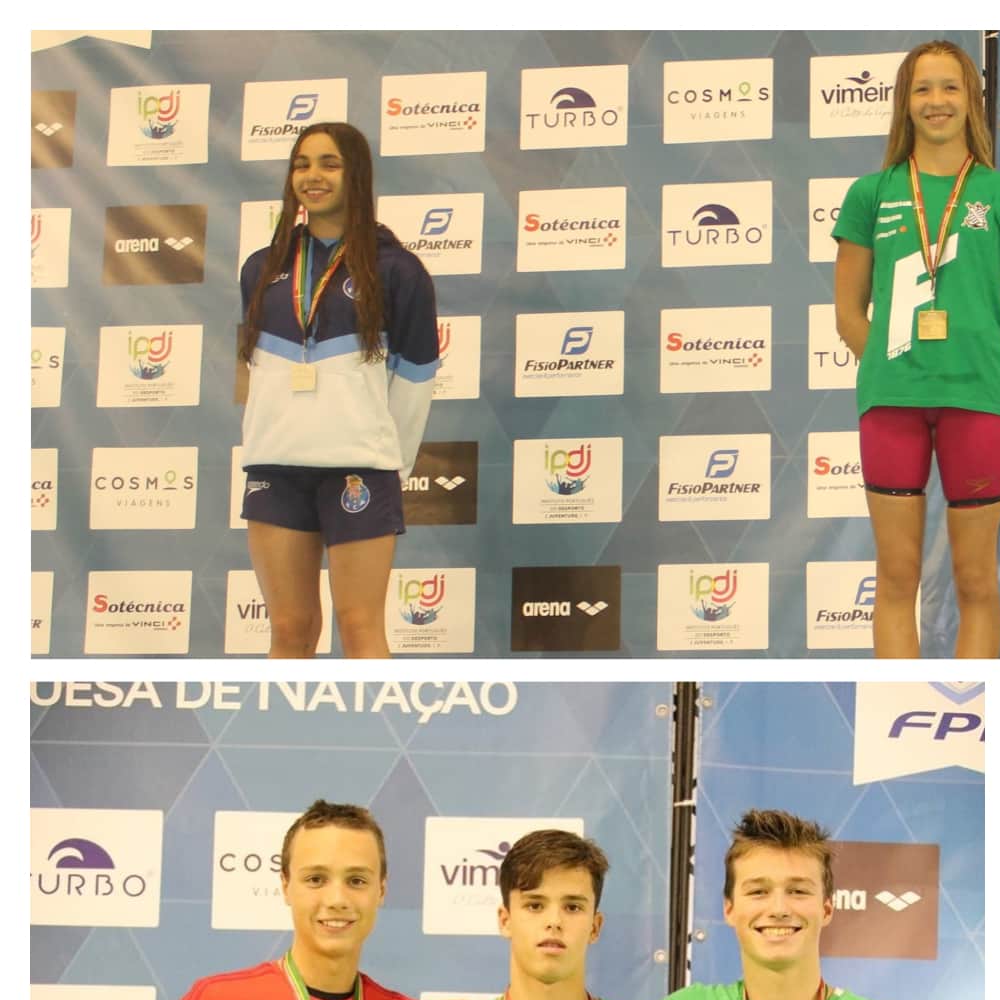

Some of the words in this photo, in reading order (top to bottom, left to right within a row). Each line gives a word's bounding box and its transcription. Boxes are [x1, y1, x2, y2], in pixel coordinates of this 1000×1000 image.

[821, 82, 893, 104] vimeir
[386, 98, 480, 116] Sotécnica
[526, 111, 618, 128] TURBO
[524, 215, 620, 233] Sotécnica
[115, 237, 159, 254] arena
[566, 238, 601, 246] VINCI
[668, 227, 762, 245] TURBO
[127, 329, 172, 362] ipdj
[666, 332, 765, 352] Sotécnica
[709, 357, 745, 365] VINCI
[544, 444, 592, 477] ipdj
[689, 569, 738, 603] ipdj
[93, 594, 184, 614] Sotécnica
[523, 601, 571, 617] arena
[176, 681, 241, 710] DE
[220, 854, 282, 873] COS
[30, 874, 146, 898] URBO
